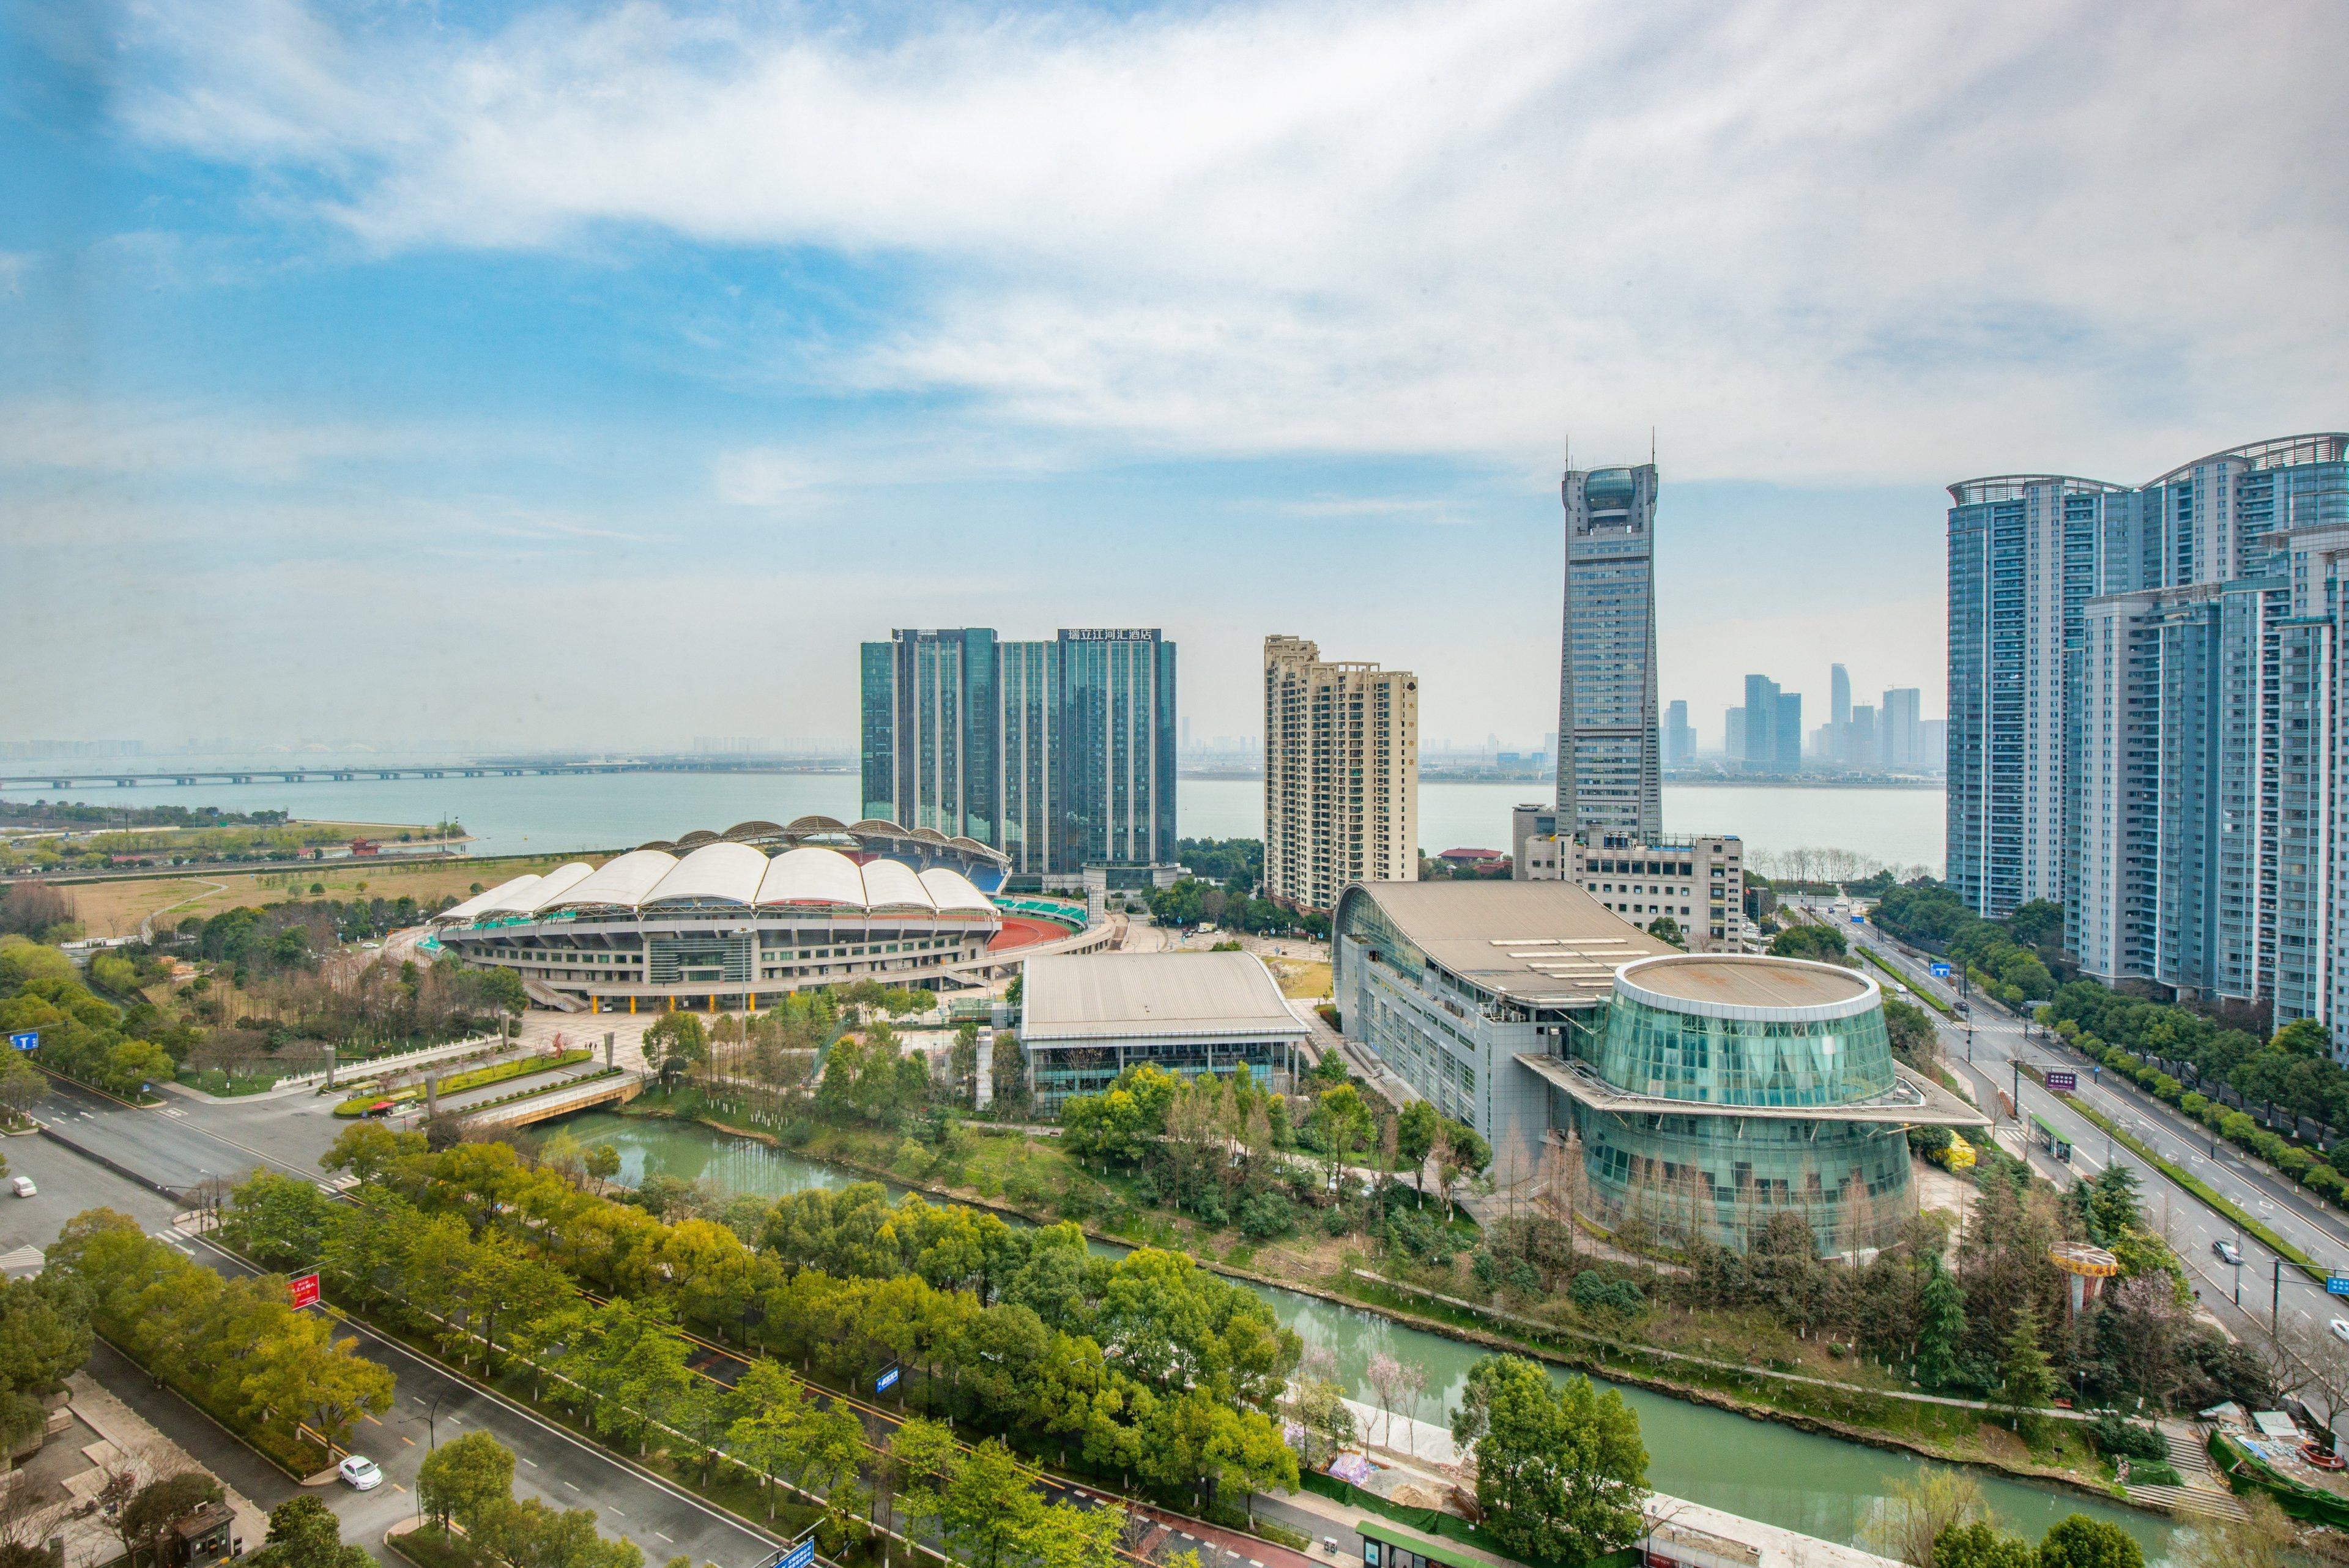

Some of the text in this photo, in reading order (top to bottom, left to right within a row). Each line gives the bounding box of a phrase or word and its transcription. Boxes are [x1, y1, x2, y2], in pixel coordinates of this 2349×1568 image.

[1068, 629, 1151, 640] 瑞立江河汇酒店
